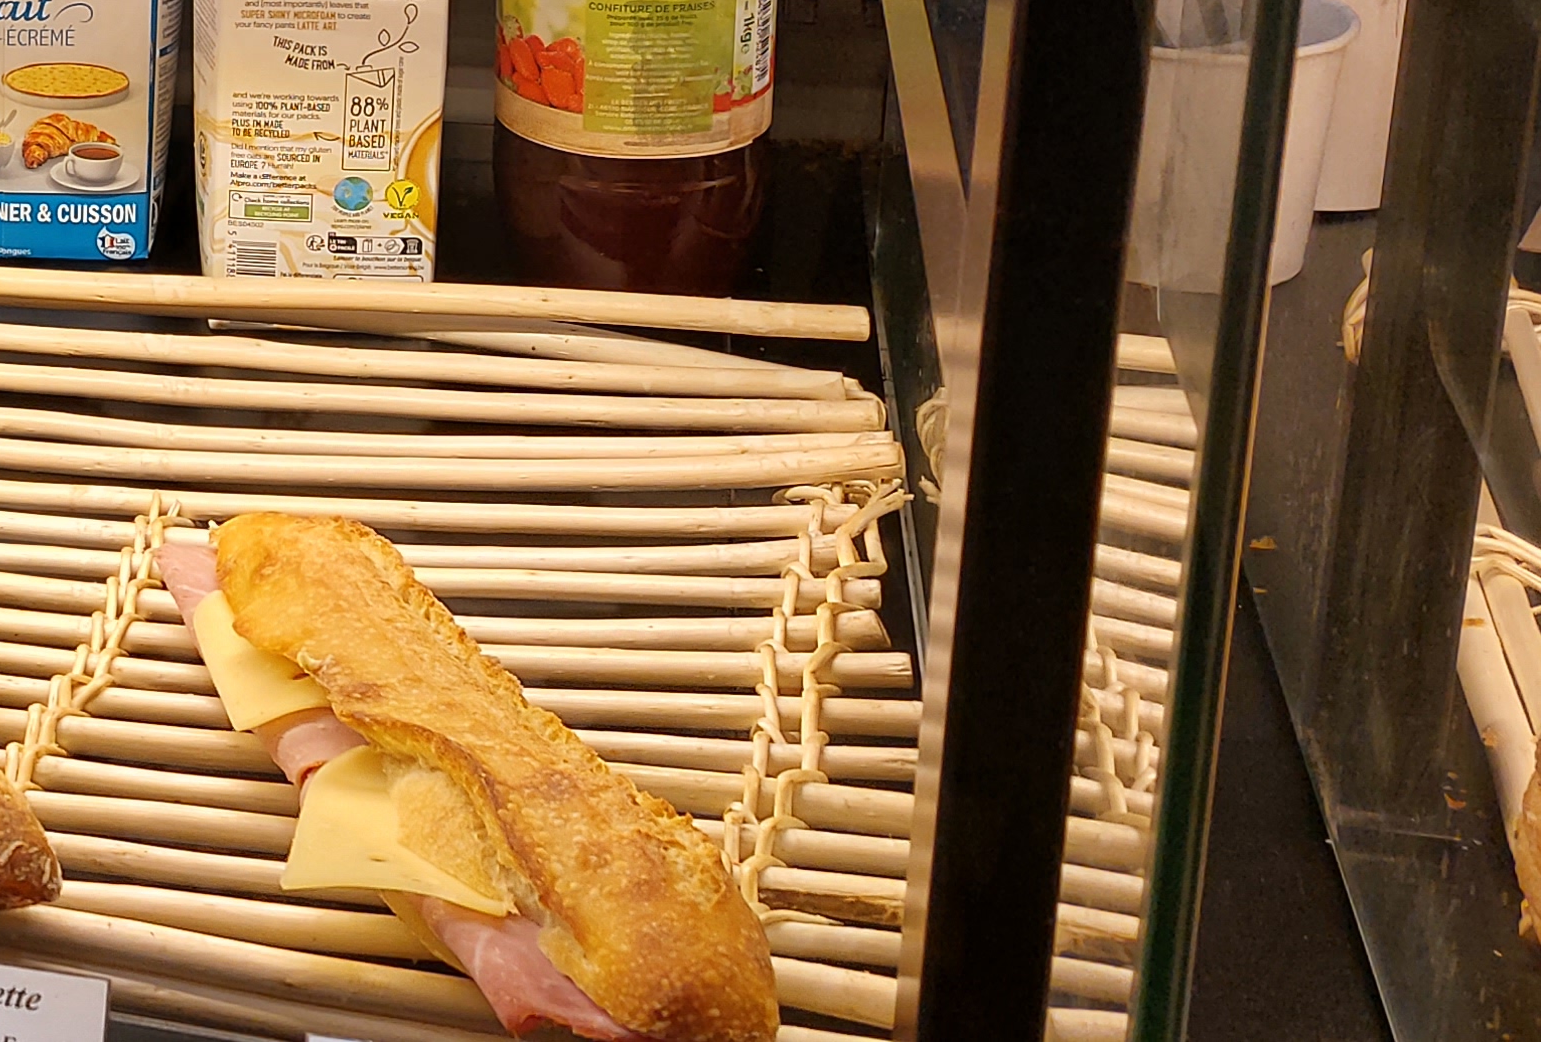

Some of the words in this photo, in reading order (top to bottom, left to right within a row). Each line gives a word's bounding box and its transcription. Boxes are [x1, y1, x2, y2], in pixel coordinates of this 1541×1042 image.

[589, 2, 652, 14] CONFITURE
[655, 4, 670, 14] DE
[673, 0, 716, 13] FRAISES
[241, 10, 265, 18] SUPER
[297, 22, 319, 30] LATTE
[273, 35, 293, 51] THIS
[293, 42, 317, 57] PACK
[319, 46, 328, 57] IS
[285, 54, 309, 71] MADE
[311, 58, 335, 72] FROM
[273, 93, 305, 102] working
[307, 94, 339, 102] towards
[255, 102, 277, 110] 100%
[350, 95, 389, 118] 88%
[232, 110, 267, 118] materials
[232, 118, 251, 127] PLUS
[263, 120, 283, 129] MADE
[349, 119, 388, 134] PLANT
[232, 128, 241, 137] TO
[243, 128, 253, 137] BE
[348, 135, 386, 150] BASED
[277, 153, 310, 162] SOURCED
[312, 154, 321, 163] IN
[231, 160, 259, 169] EUROPE
[37, 203, 52, 223] &
[57, 202, 136, 224] CUISSON
